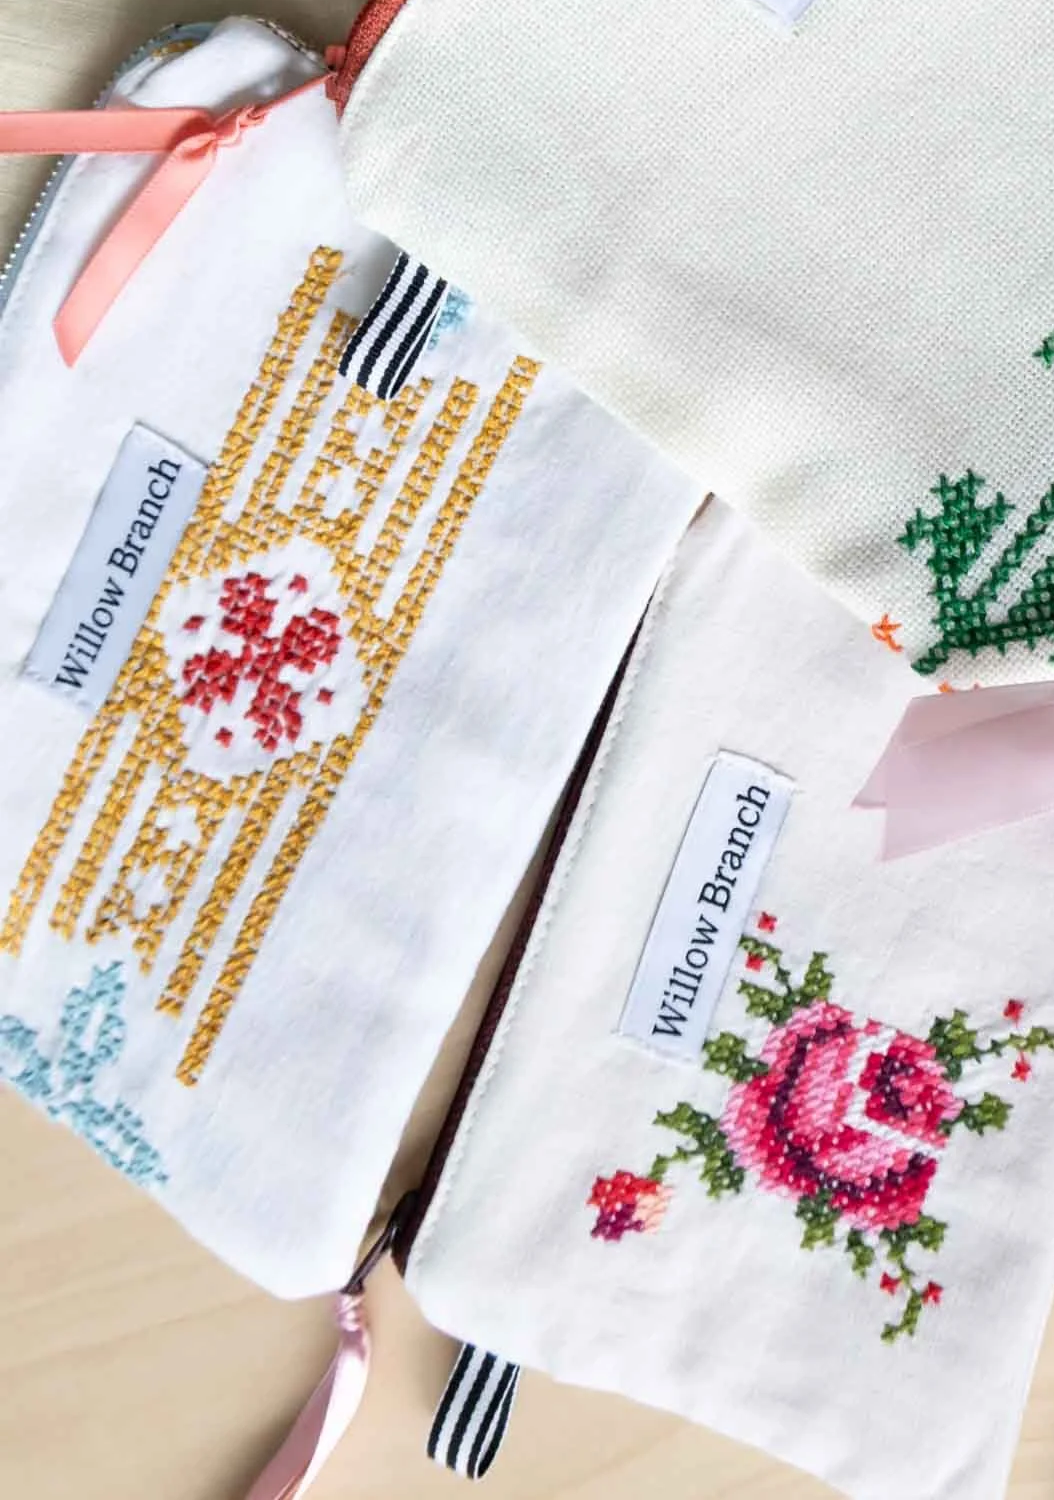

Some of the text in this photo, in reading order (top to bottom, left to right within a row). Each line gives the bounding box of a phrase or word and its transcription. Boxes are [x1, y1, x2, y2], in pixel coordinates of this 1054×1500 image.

[55, 460, 182, 688] Willow Branch
[652, 786, 770, 1036] Willow Branch
